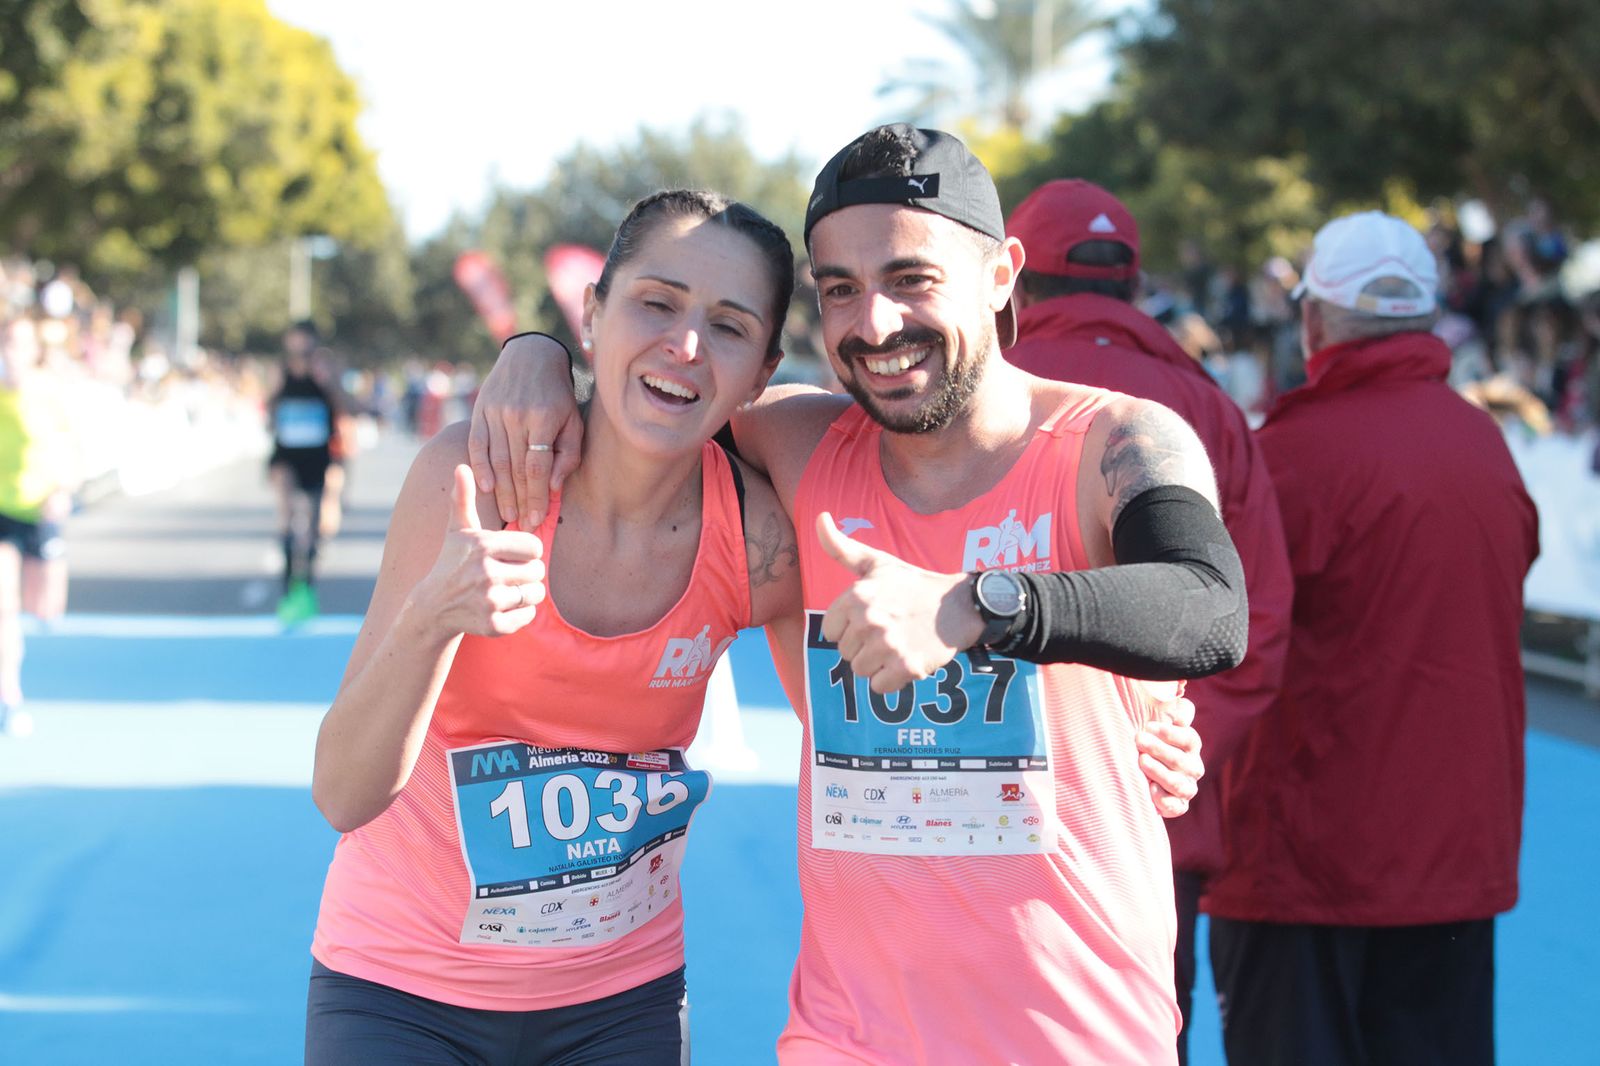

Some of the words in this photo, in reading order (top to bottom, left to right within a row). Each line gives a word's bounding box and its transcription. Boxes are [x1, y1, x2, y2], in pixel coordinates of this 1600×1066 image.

[649, 679, 671, 688] RUN
[829, 656, 1018, 725] 1037
[897, 728, 937, 746] FER
[874, 747, 913, 755] FERNANDO
[915, 747, 942, 755] TORRES
[944, 747, 961, 755] RUIZ
[529, 752, 580, 769] Almería
[826, 785, 849, 799] NEXA
[863, 787, 886, 801] CDX
[490, 771, 689, 849] 1036
[925, 819, 952, 828] Blanes
[1022, 815, 1040, 826] ego
[567, 837, 622, 860] NATA
[548, 859, 576, 873] NATALIA
[576, 854, 612, 868] GALISTEO
[482, 906, 517, 916] NEXA
[540, 901, 564, 915] CDX
